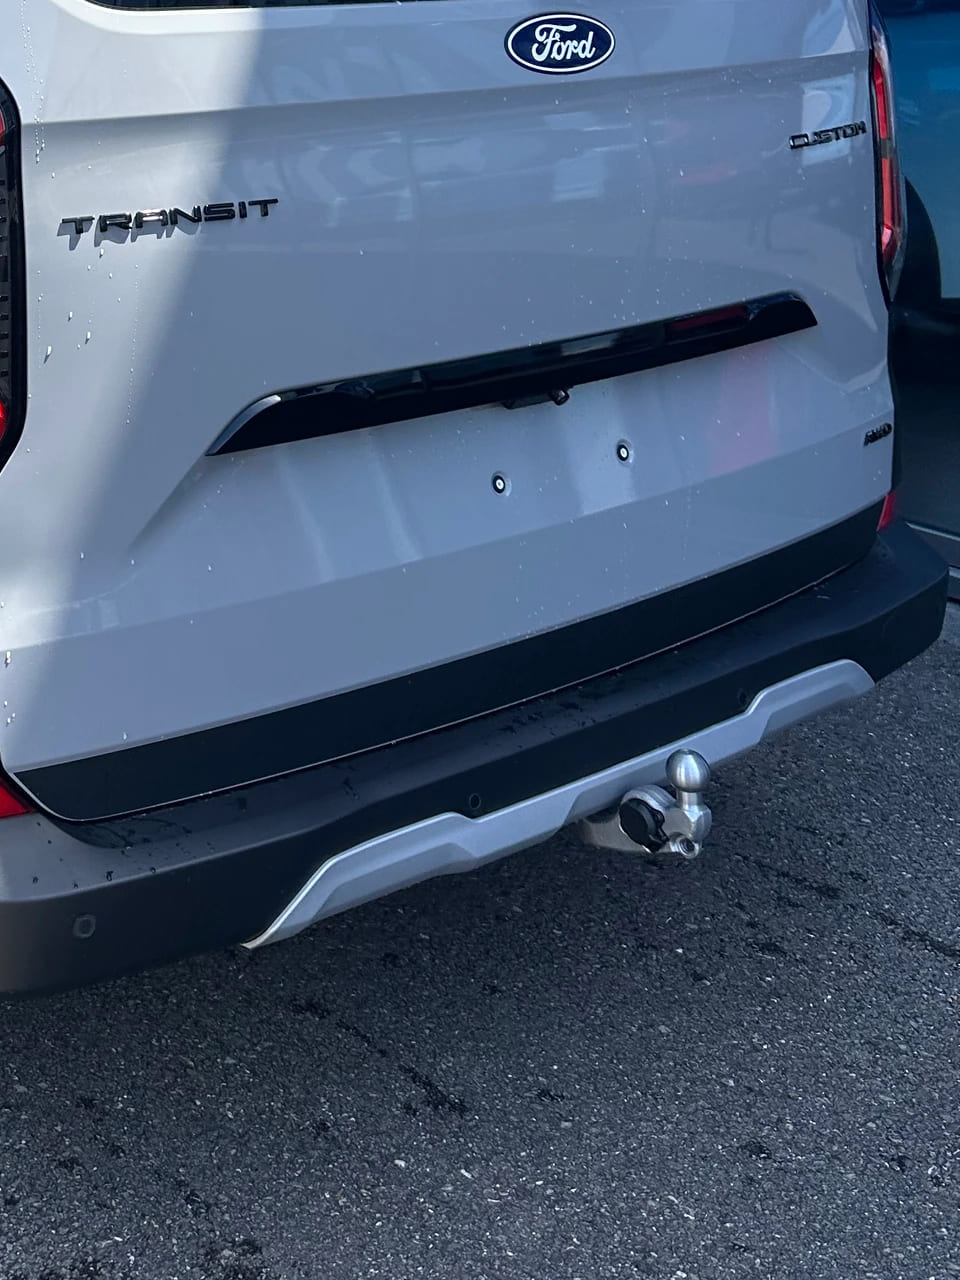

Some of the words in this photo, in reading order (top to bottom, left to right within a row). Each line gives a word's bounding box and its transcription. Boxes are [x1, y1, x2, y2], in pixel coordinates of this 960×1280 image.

[531, 23, 597, 63] Ford
[789, 121, 868, 150] CUSTOM
[61, 198, 279, 235] TRANSIT
